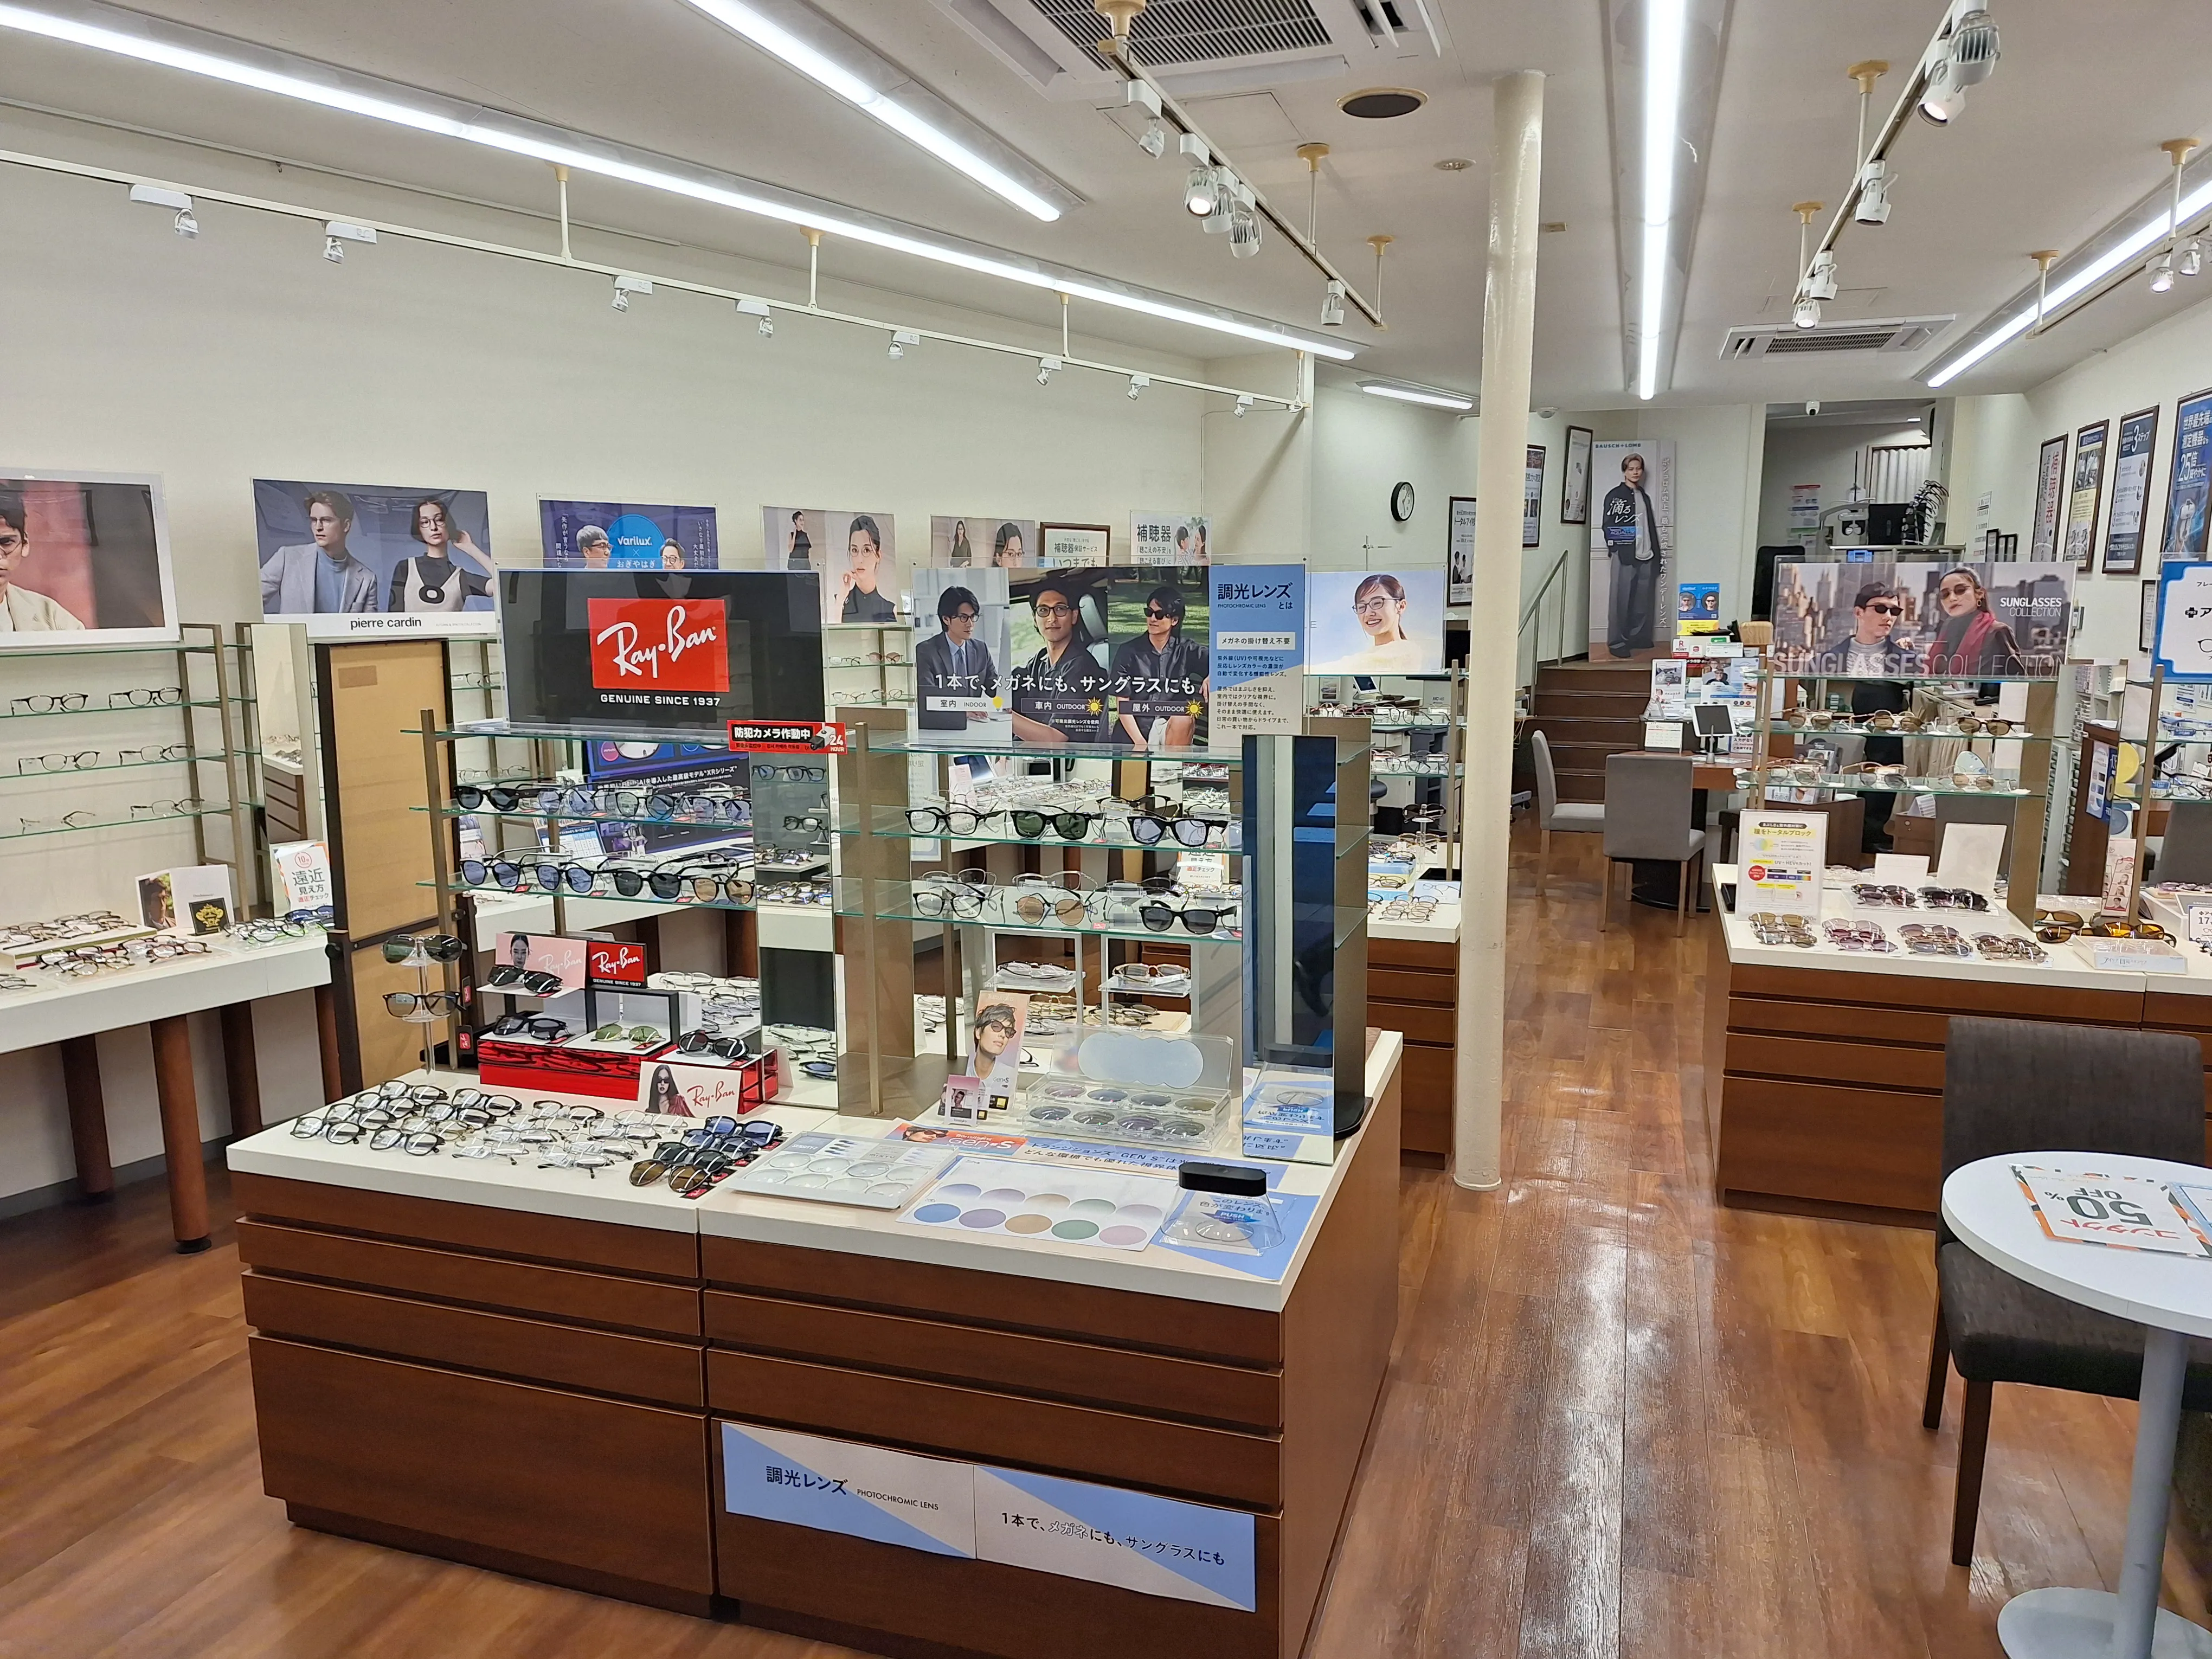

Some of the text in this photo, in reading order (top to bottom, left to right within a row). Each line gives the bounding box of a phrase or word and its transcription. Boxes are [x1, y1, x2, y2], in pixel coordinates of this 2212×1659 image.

[1136, 524, 1172, 543] 補聴器
[616, 560, 656, 569] おぎやはぎ
[1217, 582, 1294, 600] 調光レンズ
[1278, 601, 1294, 609] とは
[1999, 597, 2063, 608] SUNGLASSES
[2009, 607, 2062, 617] COLLECTION
[350, 617, 422, 631] pierre cardin
[600, 693, 721, 707] GENUINE SINCE 1937
[940, 699, 957, 708] 室内
[1034, 700, 1052, 711] 車内
[1132, 703, 1150, 712] 屋外
[734, 726, 811, 740] 防犯カメラ作動中
[829, 734, 844, 746] 24
[291, 867, 325, 886] 遠近
[299, 884, 324, 896] 見え方
[1120, 1152, 1146, 1161] GEN
[2074, 1187, 2123, 1200] OFF
[1219, 1211, 1246, 1220] PUSH
[2059, 1218, 2181, 1240] コンタクト
[765, 1464, 848, 1496] 調光レンズ
[857, 1487, 939, 1512] PHOTOCHROMIC LENS
[1001, 1512, 1226, 1566] 1本で、メガネにも、サングラスにも
